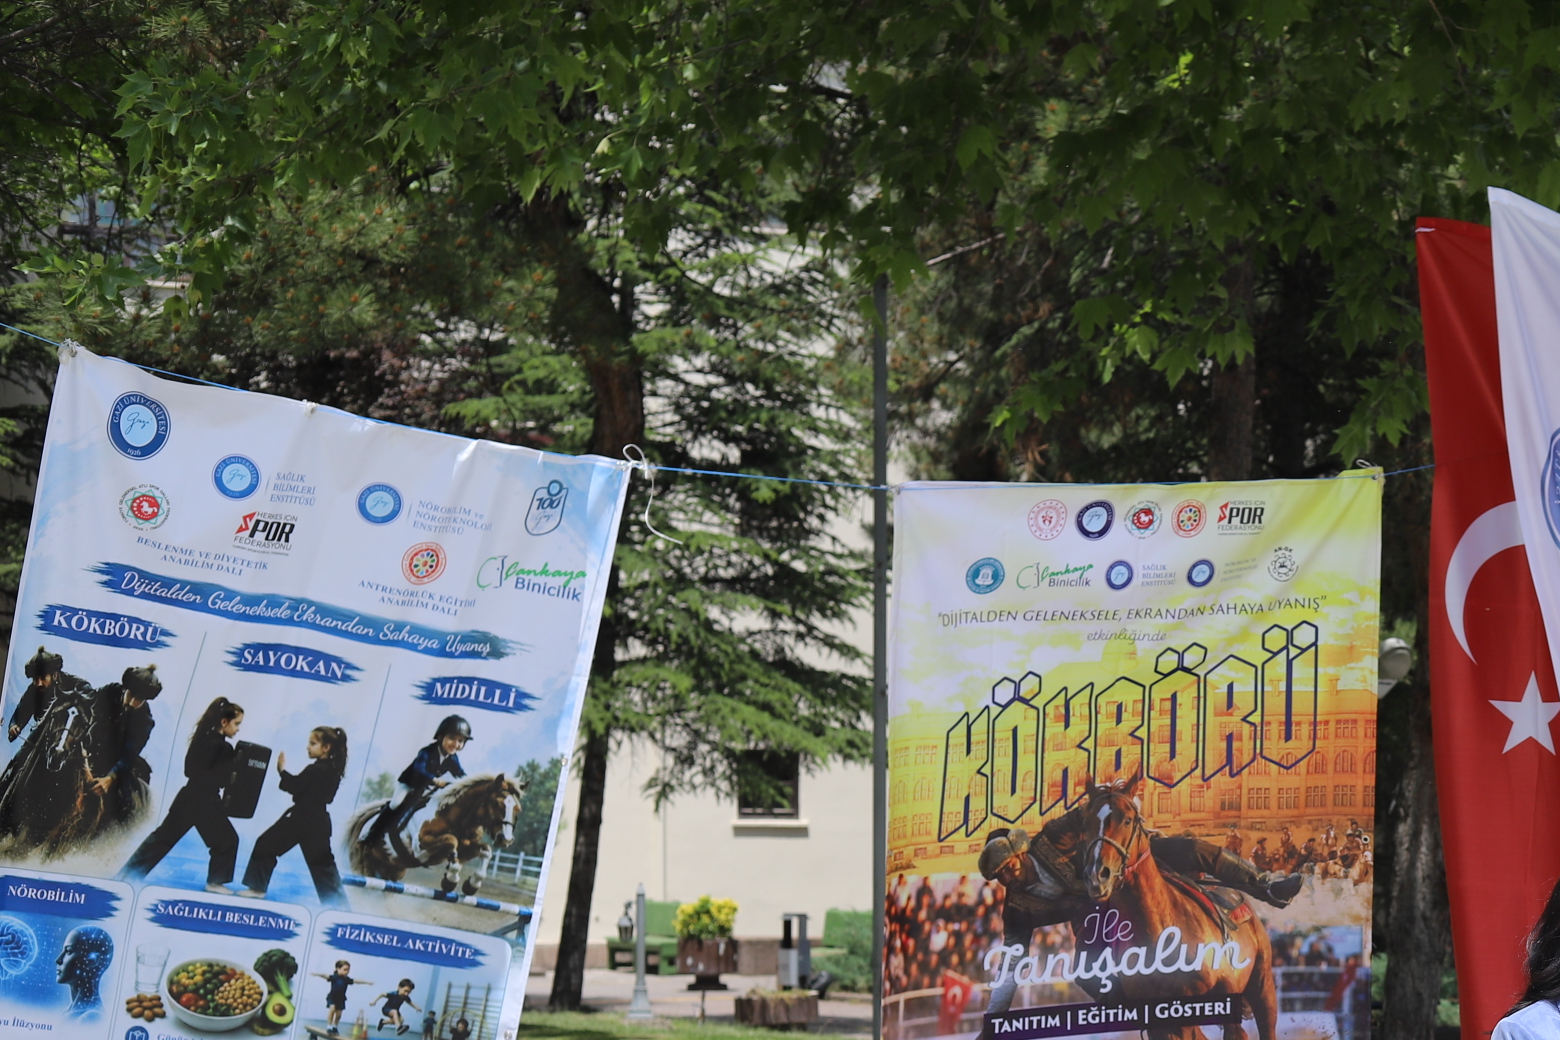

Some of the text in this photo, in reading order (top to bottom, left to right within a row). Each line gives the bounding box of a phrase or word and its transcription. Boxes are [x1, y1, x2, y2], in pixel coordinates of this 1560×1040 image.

[112, 393, 167, 435] GAZİ ÜNİVERSİTESİ
[127, 447, 141, 456] 1926
[276, 472, 306, 483] SAĞLIK
[270, 494, 316, 506] ENSTİTÜSÜ
[273, 483, 316, 495] BİLİMLERİ
[536, 496, 564, 510] 100
[1218, 502, 1264, 524] SPOR
[136, 536, 196, 558] BESLENME
[198, 550, 212, 560] VE
[213, 551, 268, 570] DİYETETİK
[234, 536, 292, 551] FEDERASYONU
[160, 554, 243, 576] ANABİLİM DALI
[504, 562, 588, 587] Çankaya
[1041, 562, 1094, 582] Çankaya
[358, 580, 435, 600] ANTRENÖRLÜK
[515, 576, 582, 602] Binicilik
[1048, 577, 1091, 588] Binicilik
[121, 571, 203, 605] Dijitalden
[208, 591, 292, 620] Geleneksele
[294, 603, 376, 637] Ekrandan
[379, 623, 440, 650] Sahaya
[378, 595, 458, 617] ANABİLİM DALI
[1022, 609, 1122, 622] GELENEKSELE,
[1126, 606, 1206, 620] EKRANDAN
[1208, 603, 1264, 616] SAHAYA
[52, 608, 162, 644] KÖKBÖRÜ
[1087, 628, 1167, 645] etkinliğinde
[241, 648, 346, 680] SAYOKAN
[432, 678, 518, 708] MİDİLLİ
[938, 620, 1318, 842] KÖKBÖRÜ
[8, 884, 86, 905] NÖROBİLİM
[156, 902, 298, 931] SAĞLIKLI BESLENME
[1084, 906, 1134, 946] İle
[336, 925, 475, 960] FİZİKSEL AKTİVİTE
[982, 926, 1250, 994] Tanışalım
[1078, 1004, 1138, 1025] EĞİTİM
[1154, 998, 1232, 1020] GÖSTERİ
[12, 1016, 53, 1031] İlüzyonu
